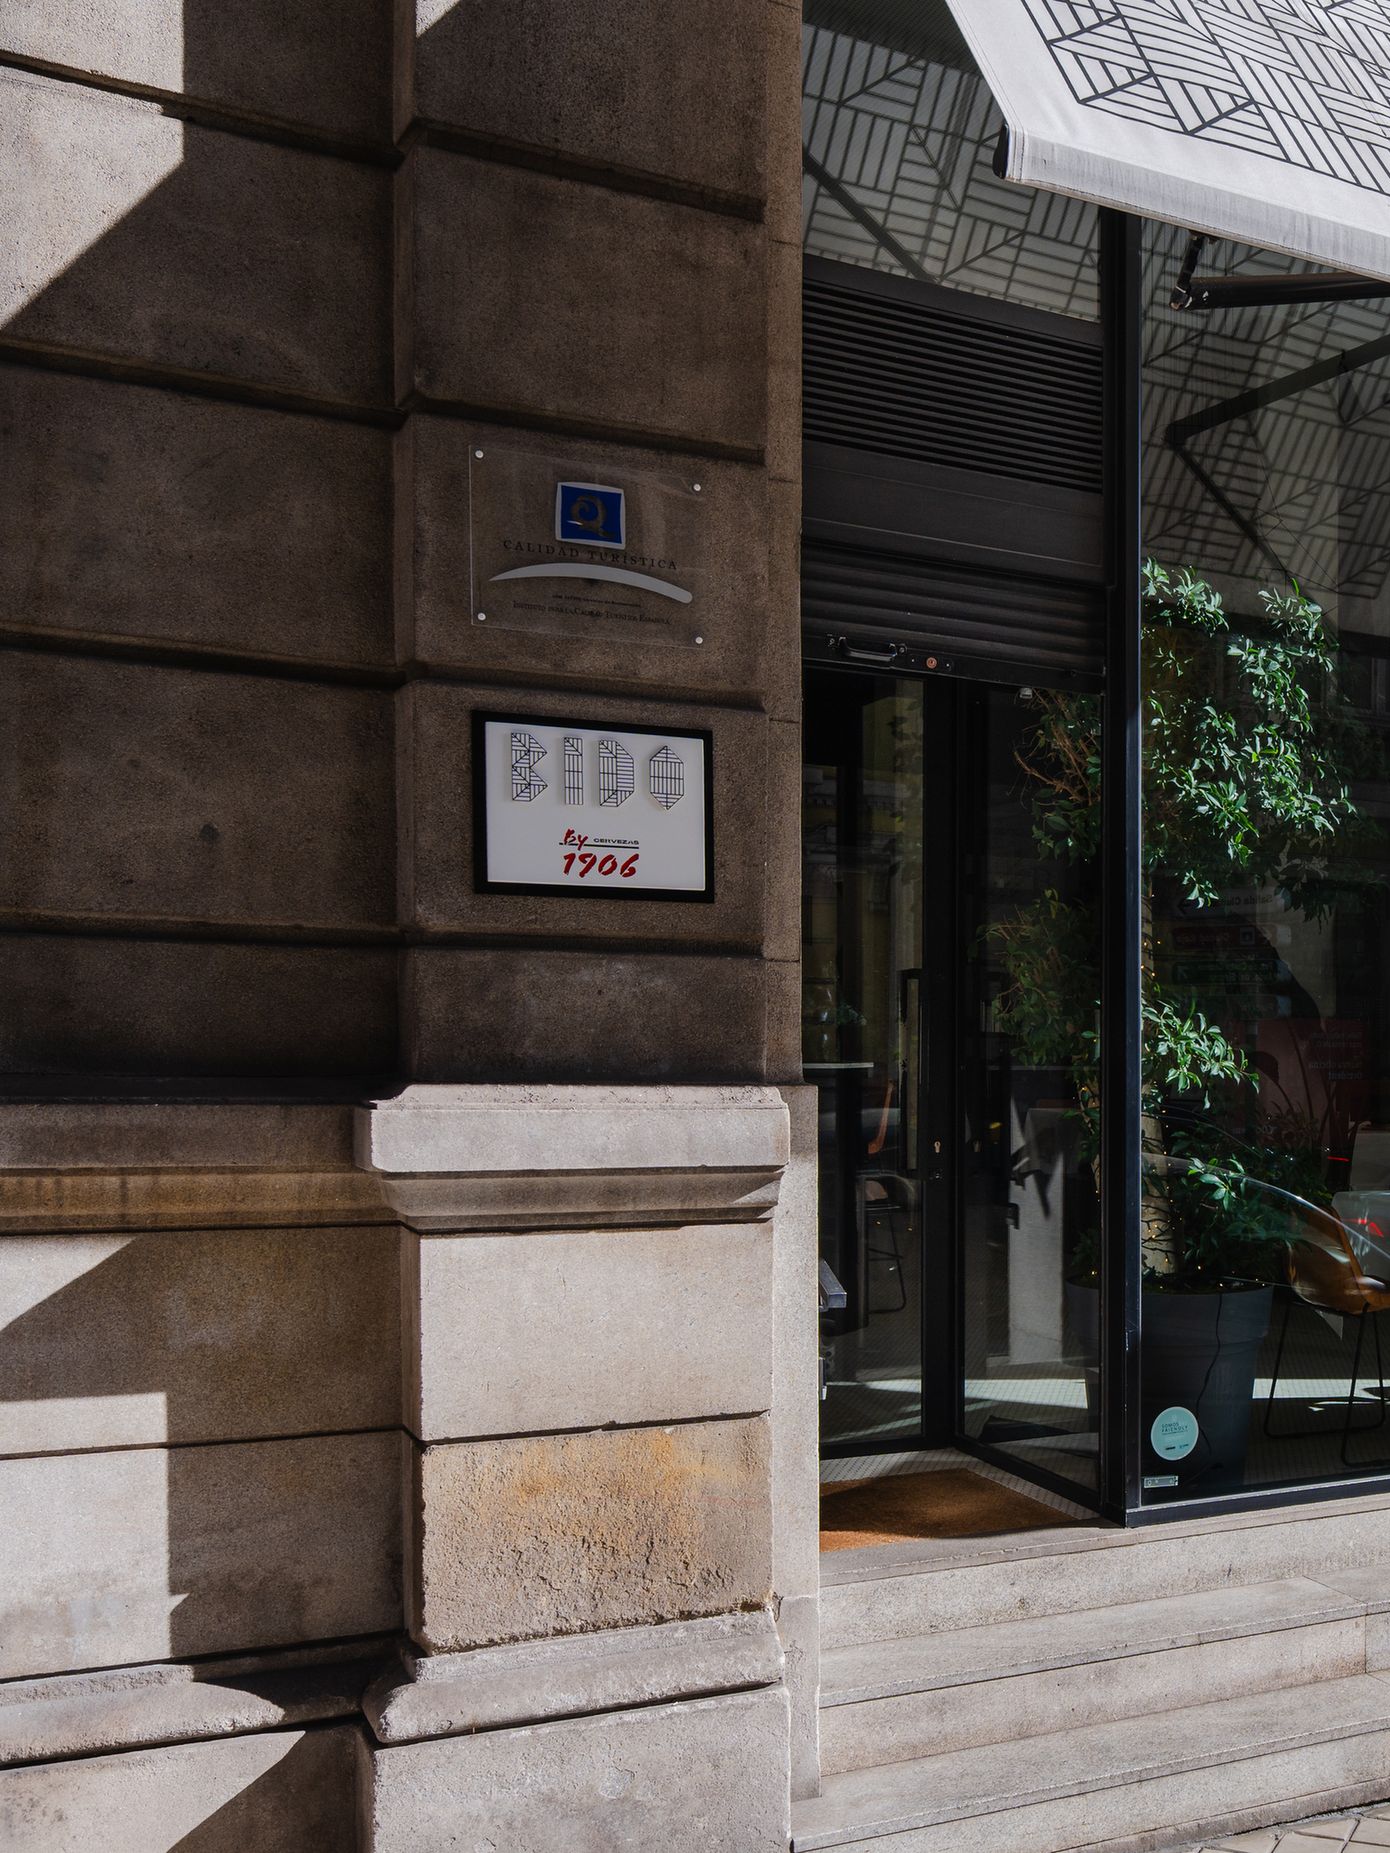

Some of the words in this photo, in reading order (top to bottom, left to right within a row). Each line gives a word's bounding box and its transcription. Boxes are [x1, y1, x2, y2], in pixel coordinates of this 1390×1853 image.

[503, 539, 579, 557] CALIDAD
[588, 550, 677, 570] TURÍSTICA
[511, 732, 684, 810] BIDO
[563, 852, 640, 878] 1906
